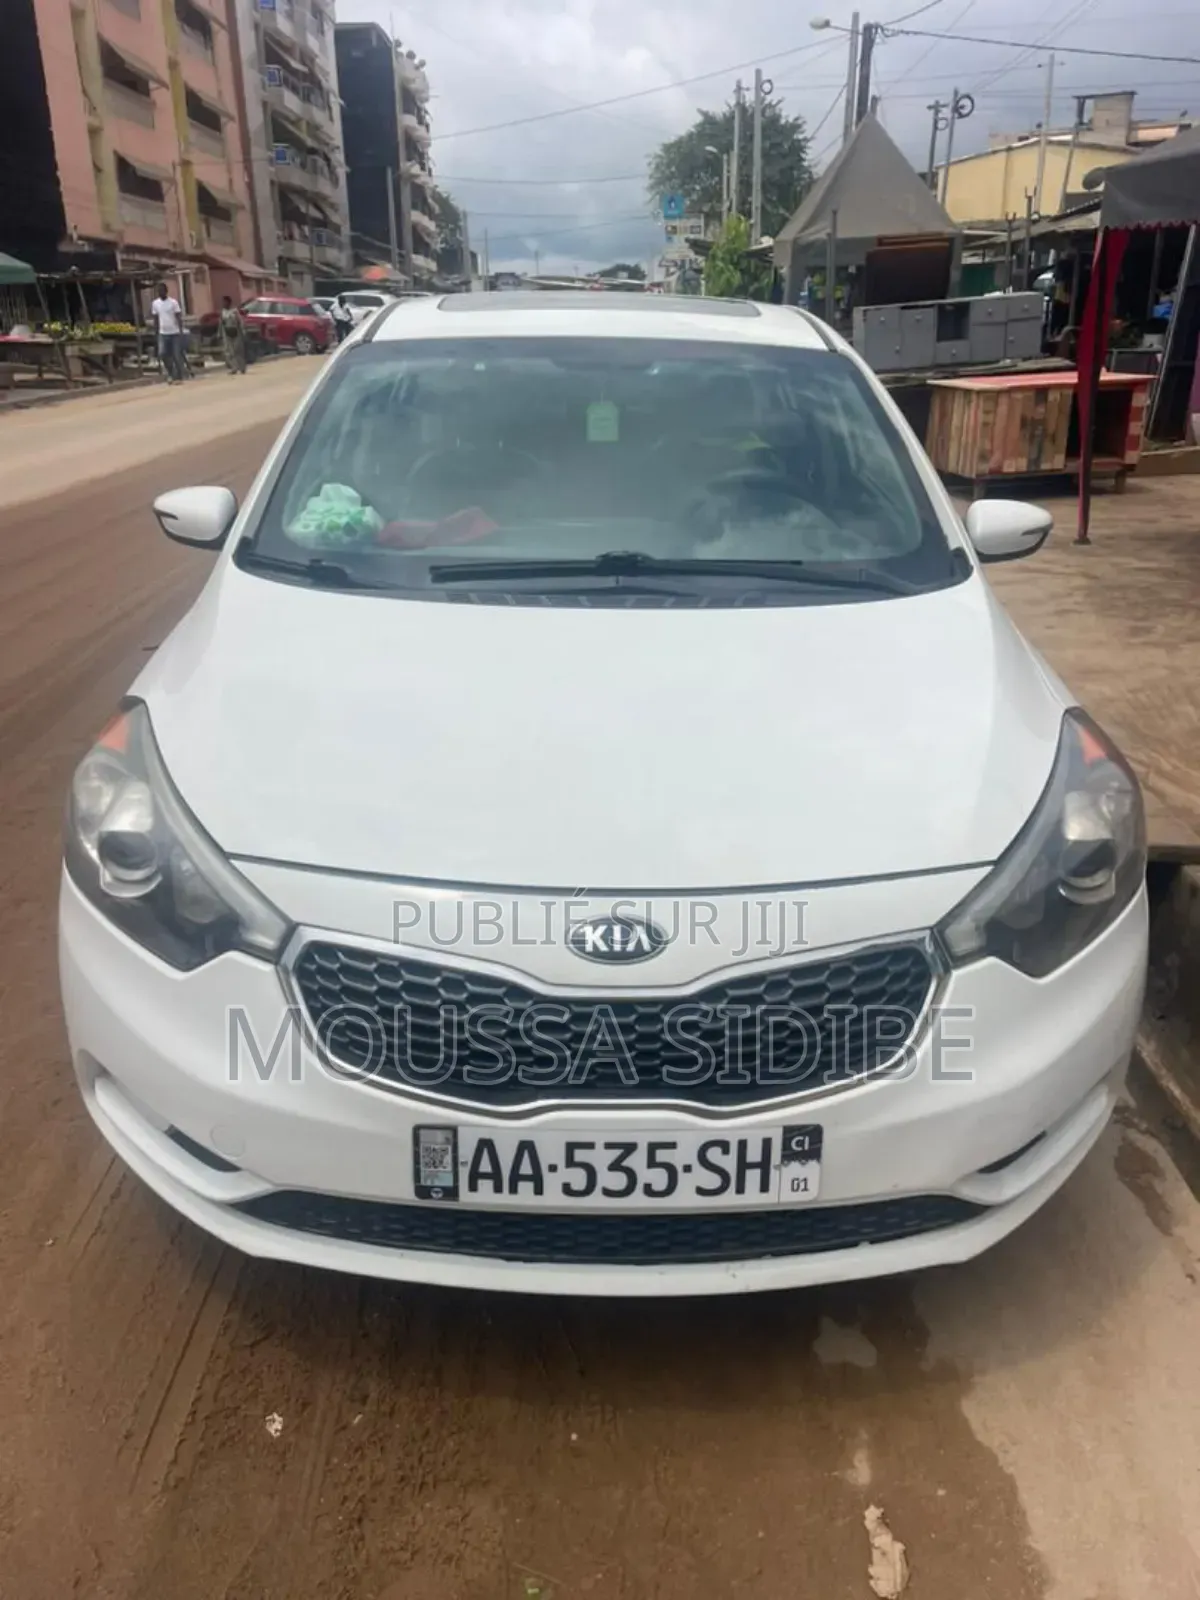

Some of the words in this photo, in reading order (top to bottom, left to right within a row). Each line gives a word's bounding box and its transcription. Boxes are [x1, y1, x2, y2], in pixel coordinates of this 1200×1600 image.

[579, 925, 654, 953] KIA
[790, 1135, 810, 1151] CI
[790, 1176, 810, 1193] 01
